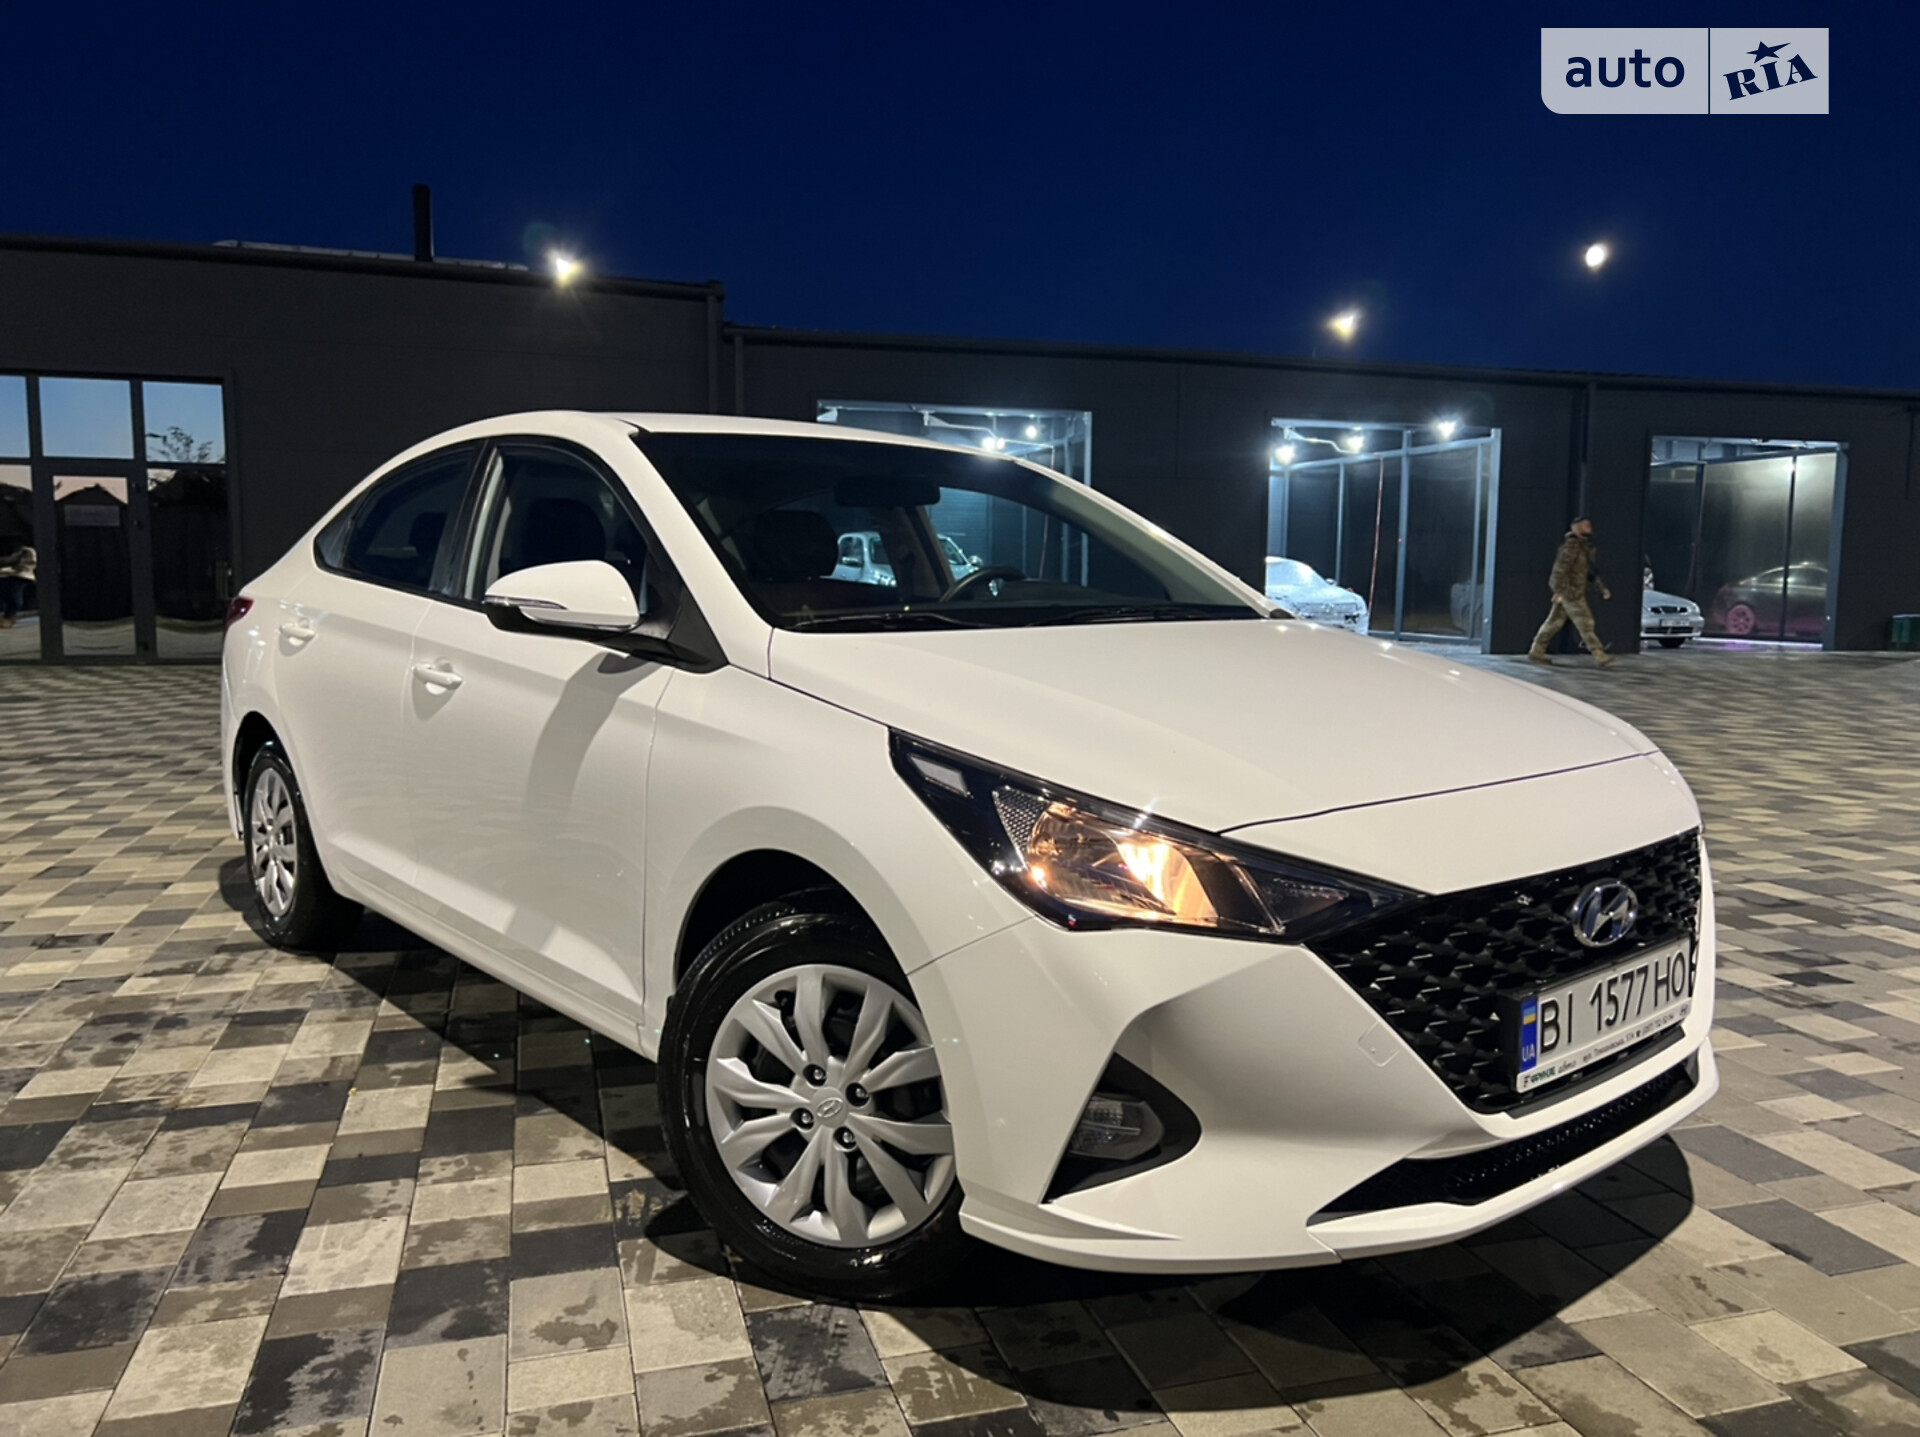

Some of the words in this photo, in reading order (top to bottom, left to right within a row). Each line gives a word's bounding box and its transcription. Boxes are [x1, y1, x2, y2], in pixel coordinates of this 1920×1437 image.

[1540, 992, 1574, 1055] BI
[1589, 965, 1650, 1032] 1577
[1654, 951, 1686, 1008] HO
[1522, 1044, 1536, 1062] UA
